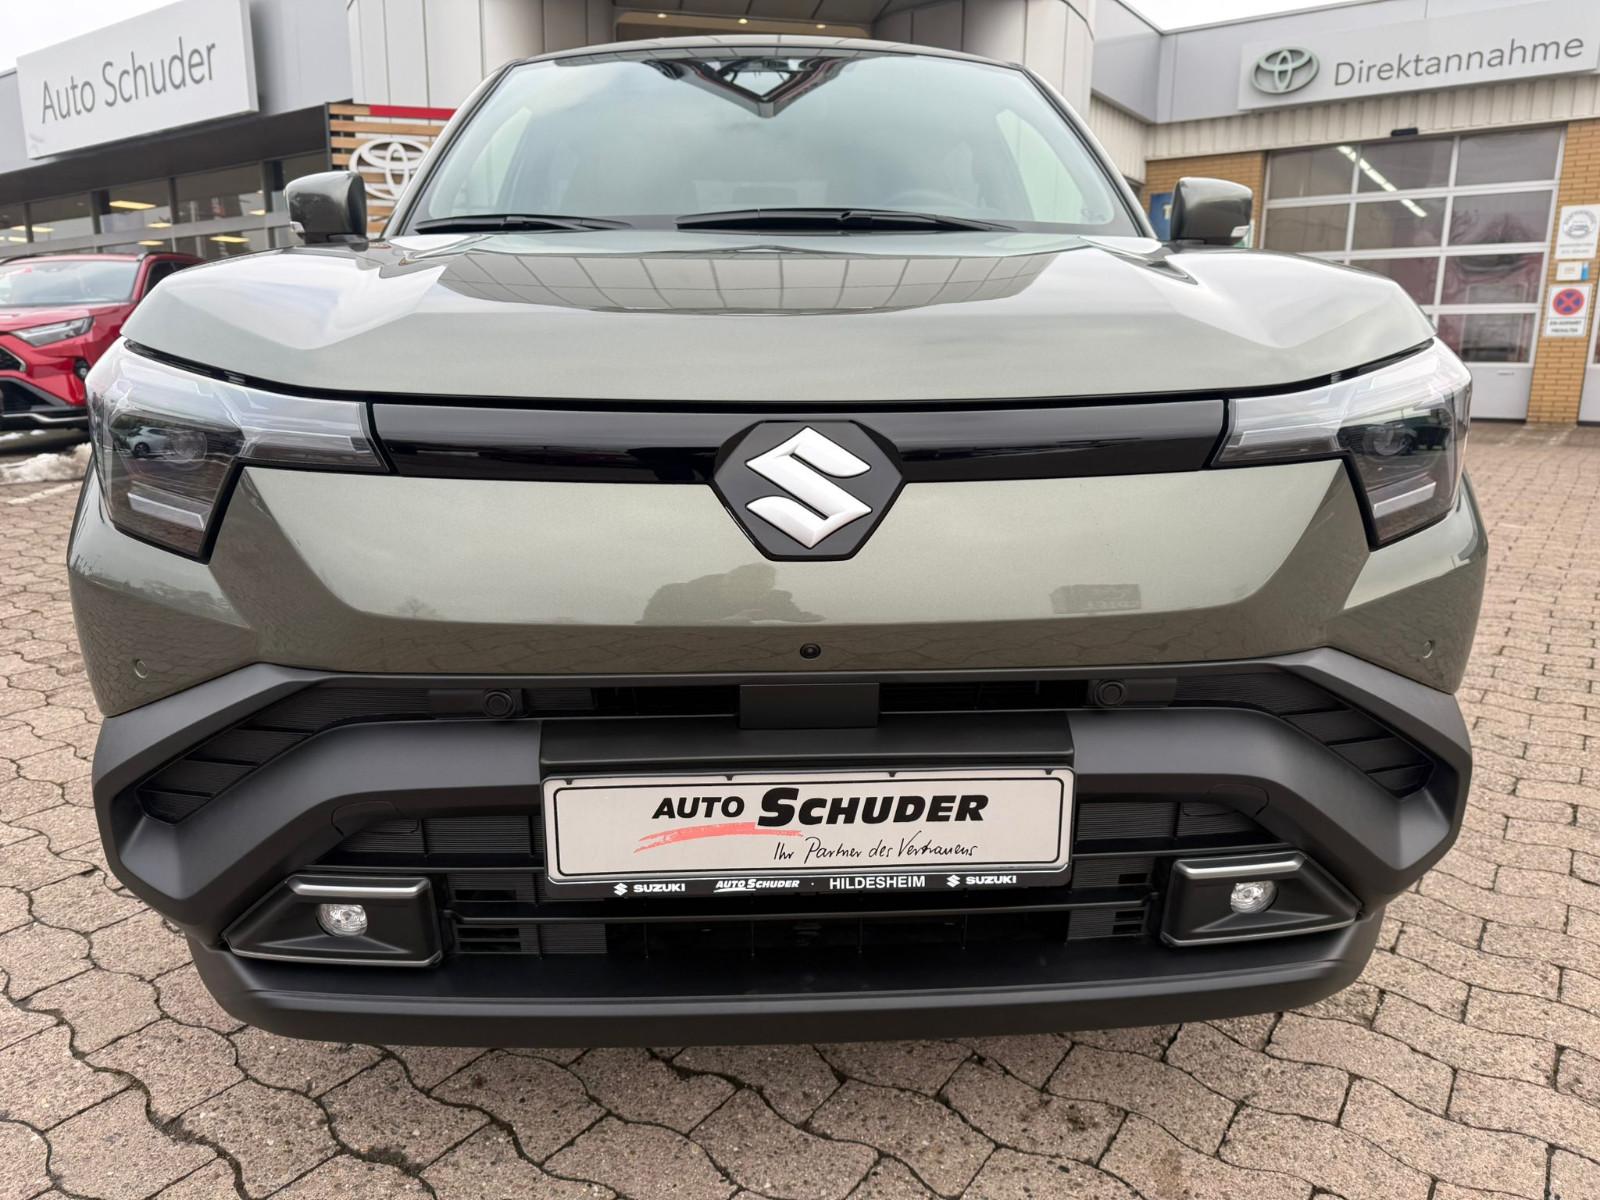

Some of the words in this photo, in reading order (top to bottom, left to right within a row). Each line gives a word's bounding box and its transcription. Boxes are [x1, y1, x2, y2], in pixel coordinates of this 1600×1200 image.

[41, 75, 96, 124] Auto
[102, 36, 216, 107] Schuder
[1334, 38, 1584, 86] Direktannahme
[652, 796, 745, 819] AUTO
[757, 787, 989, 827] SCHUDER
[773, 841, 794, 861] Ihr
[804, 836, 861, 864] Partner
[868, 840, 894, 858] des
[897, 830, 978, 858] Vertrauens
[633, 883, 686, 893] SUZUKI
[715, 879, 746, 889] AUTO
[746, 878, 800, 889] SCHUDER
[829, 875, 926, 890] HILDESHEIM
[965, 875, 1017, 885] SUZUKI
